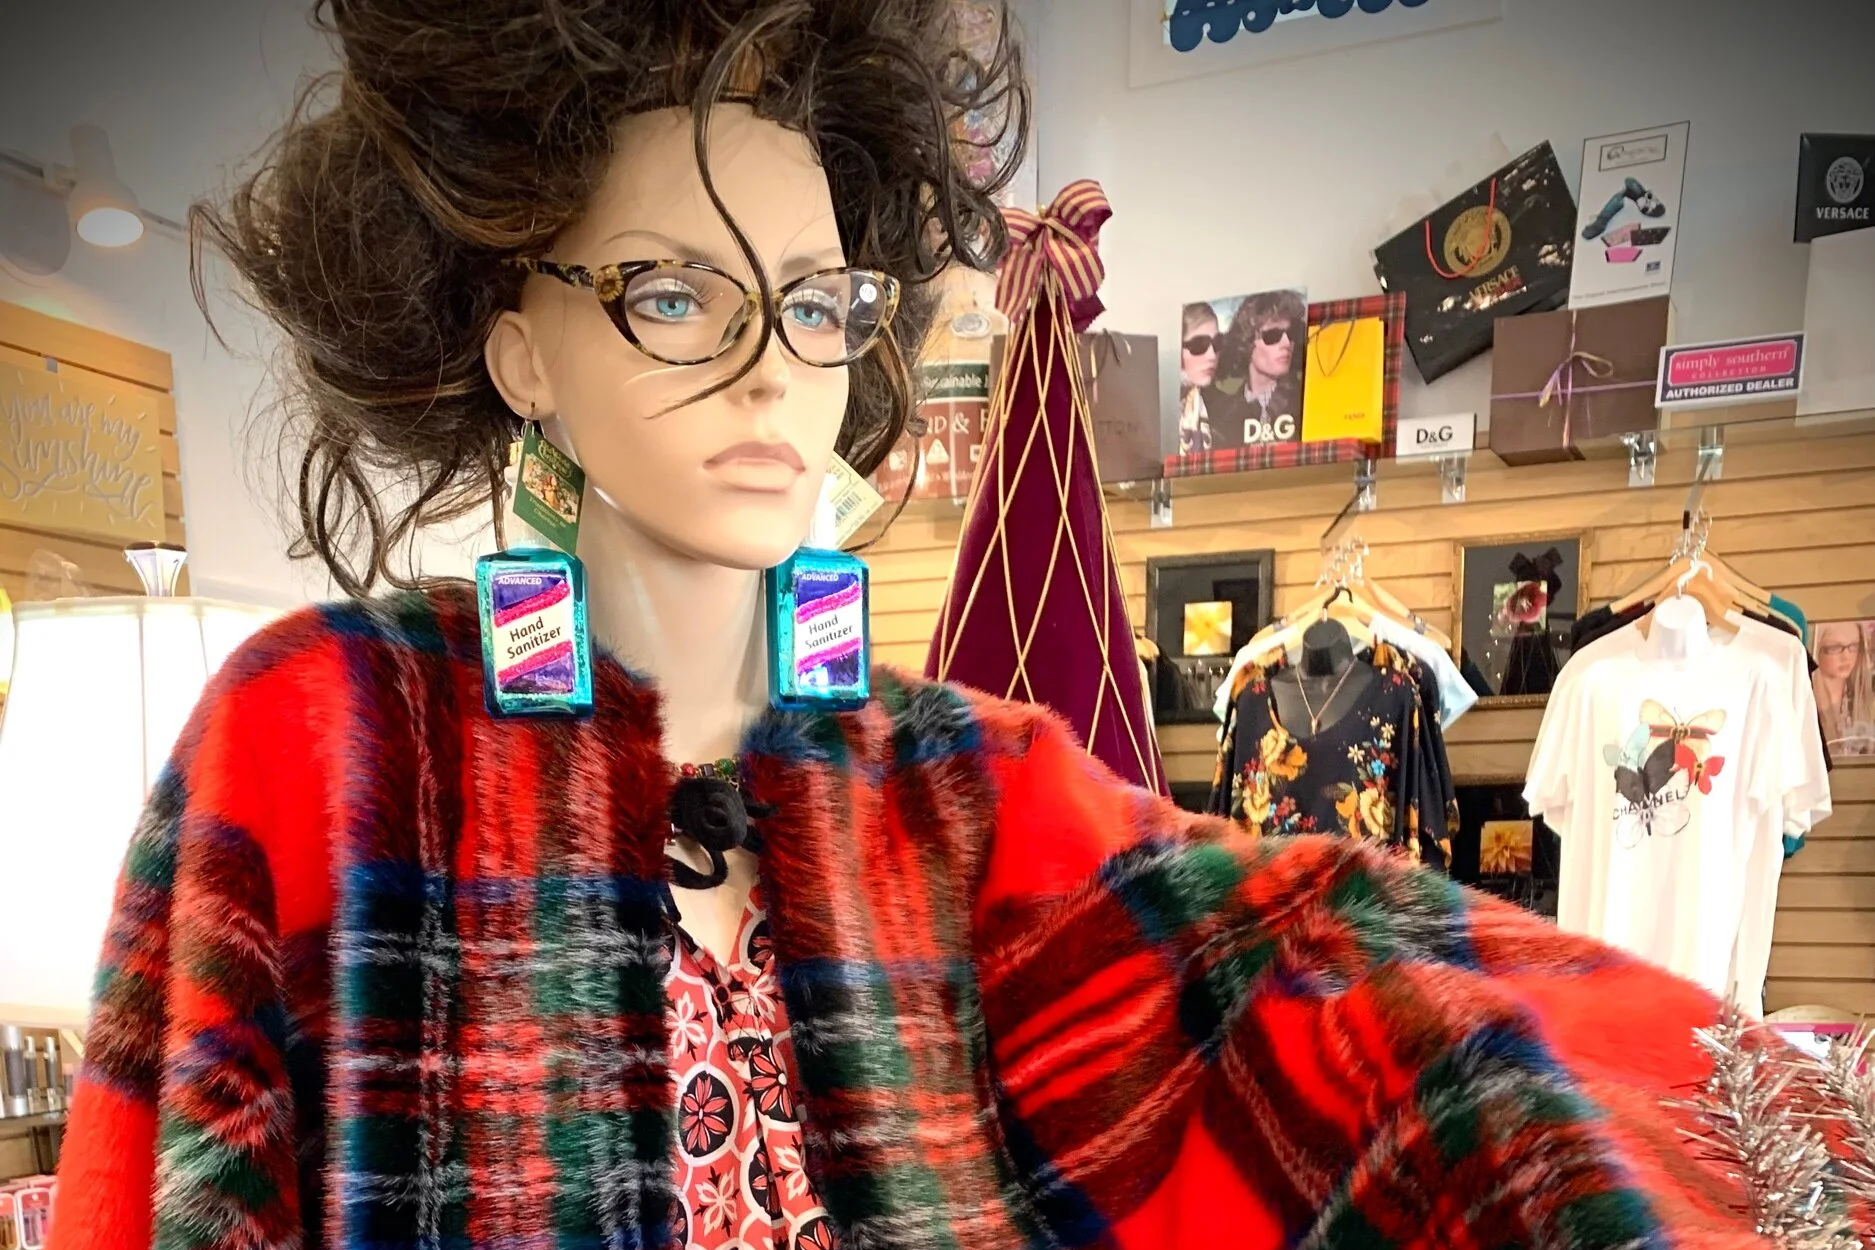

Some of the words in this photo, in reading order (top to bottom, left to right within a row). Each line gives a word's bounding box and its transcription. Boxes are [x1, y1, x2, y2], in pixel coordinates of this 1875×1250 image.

[1816, 207, 1870, 219] VERSACE
[1469, 265, 1520, 303] VERSACE
[1675, 354, 1720, 372] simply
[1726, 348, 1788, 366] southern
[1691, 366, 1767, 379] COLLECTION
[1666, 383, 1743, 399] AUTHORIZED
[1746, 378, 1794, 391] DEALER
[102, 411, 142, 461] my
[1243, 414, 1296, 444] D&G
[1416, 426, 1453, 444] D&G
[498, 576, 543, 585] ADVANCED
[801, 572, 839, 582] ADVANCED
[509, 616, 544, 642] Hand
[808, 614, 839, 635] Hand
[507, 626, 561, 659] Sanitizer
[805, 624, 853, 649] Sanitizer
